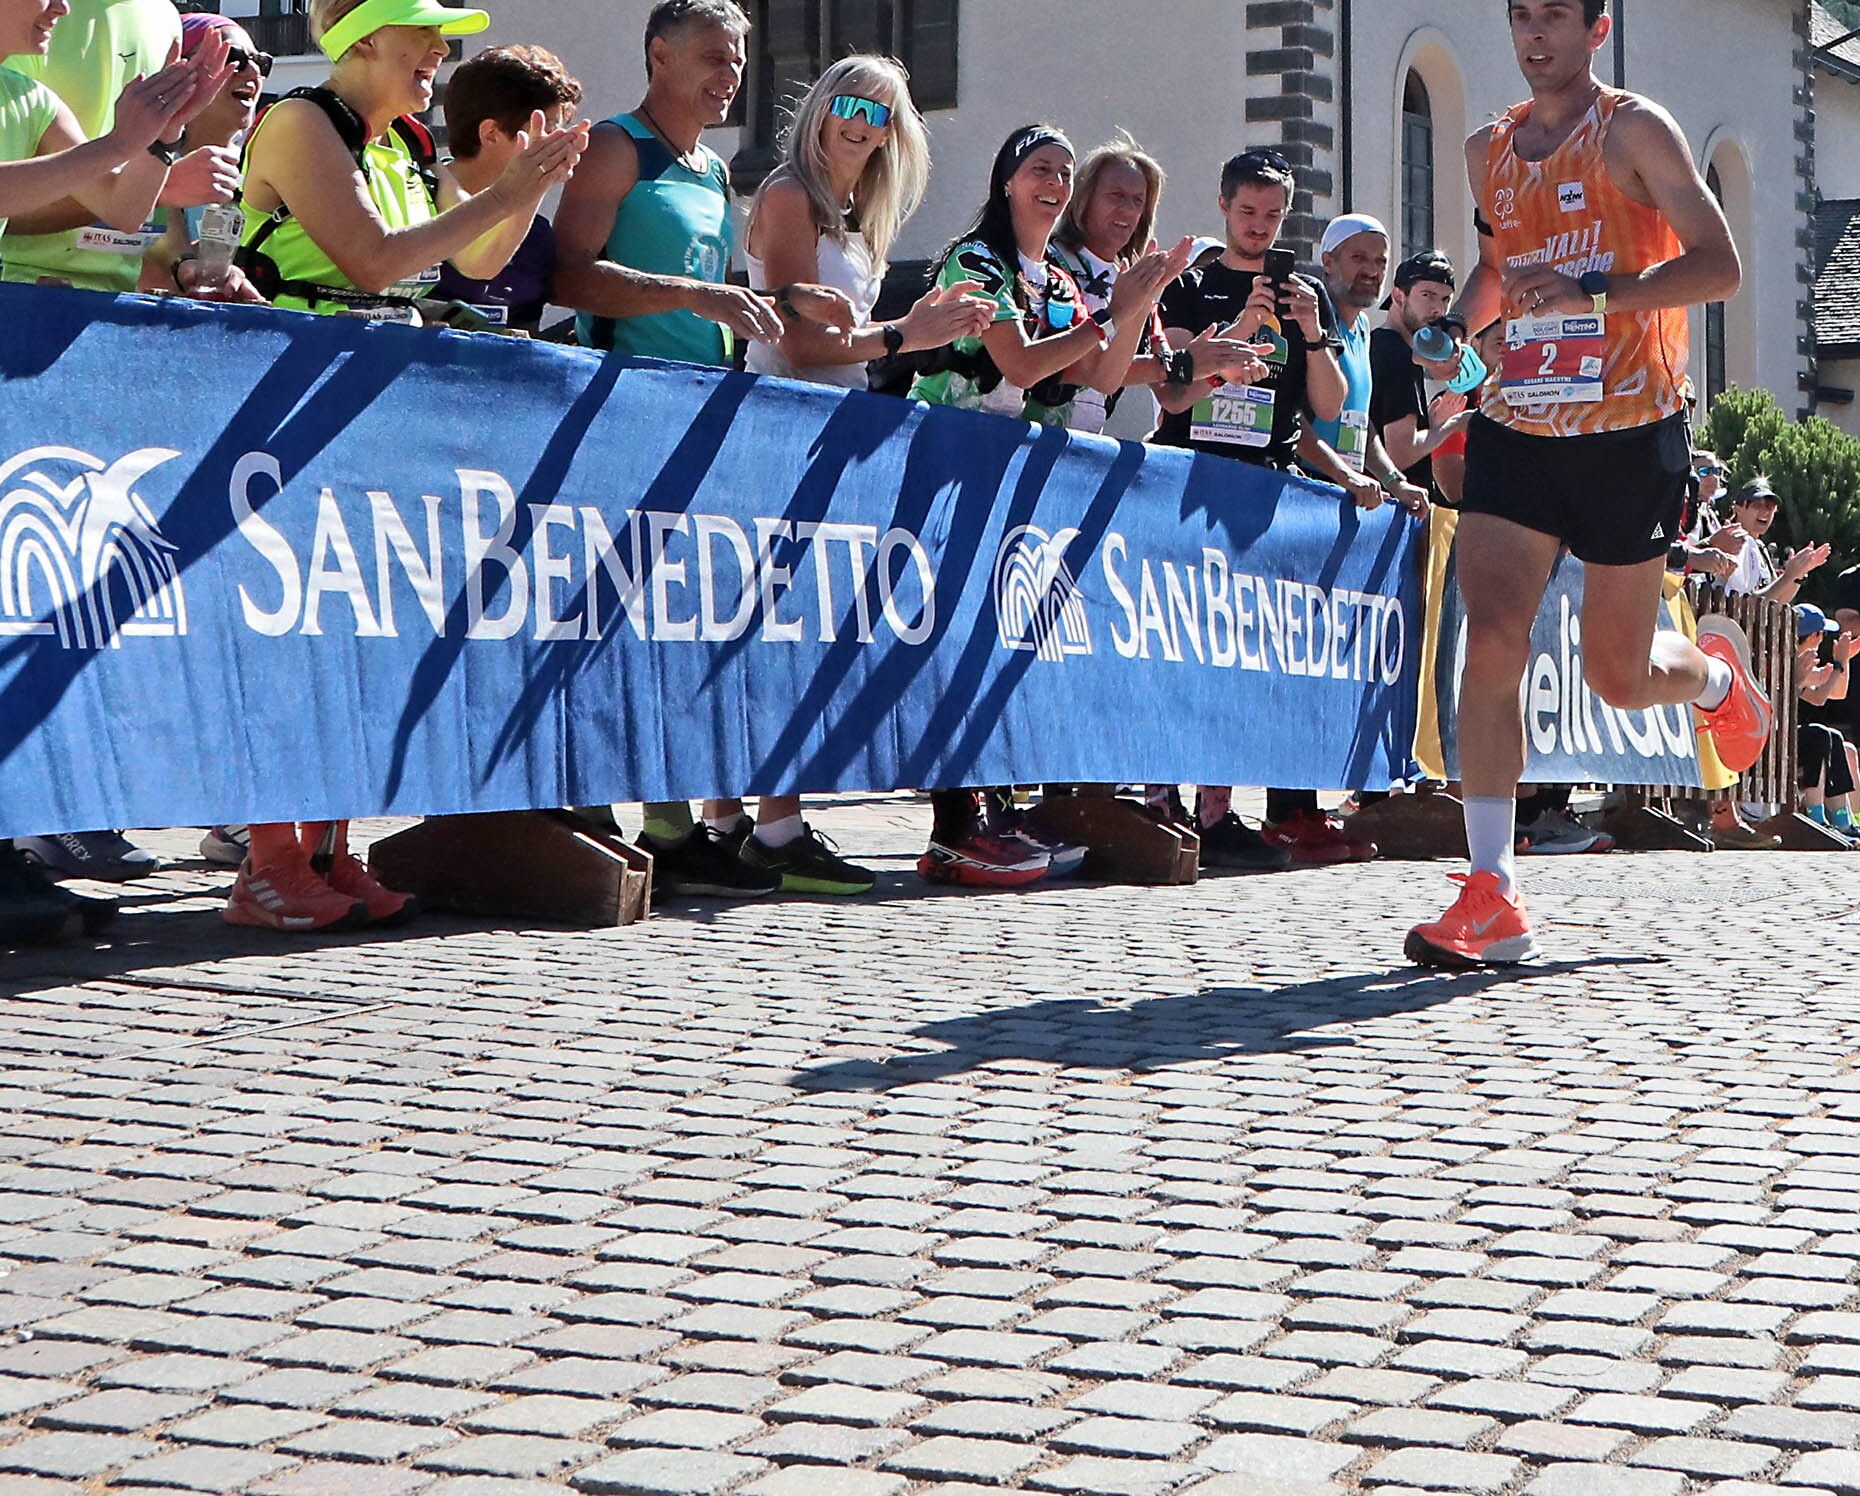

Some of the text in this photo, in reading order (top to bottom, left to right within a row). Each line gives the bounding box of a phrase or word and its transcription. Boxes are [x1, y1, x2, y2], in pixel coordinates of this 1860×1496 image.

[1538, 343, 1557, 375] 2
[1527, 390, 1560, 398] SALOMON
[1211, 399, 1257, 426] 1255
